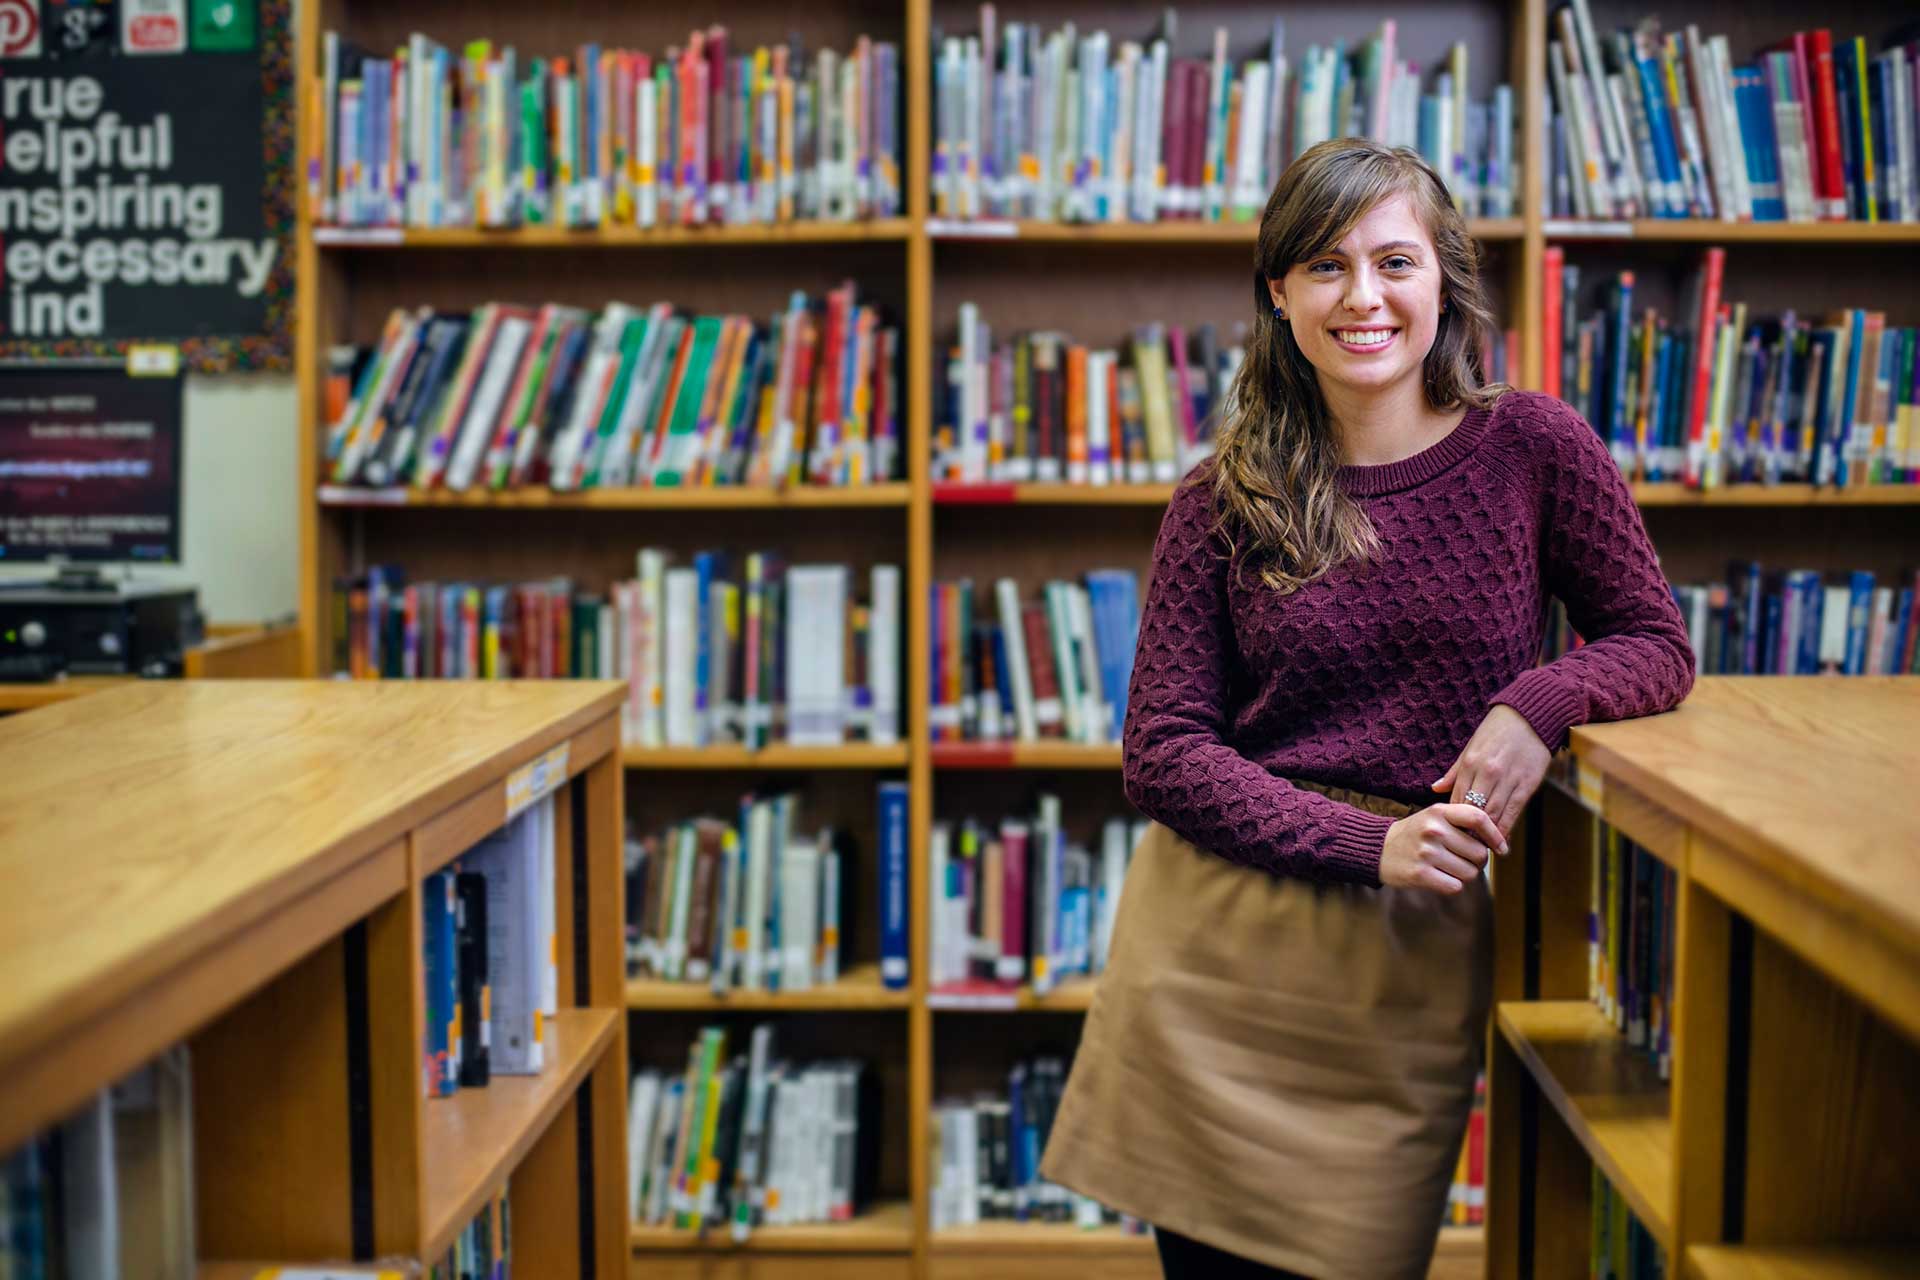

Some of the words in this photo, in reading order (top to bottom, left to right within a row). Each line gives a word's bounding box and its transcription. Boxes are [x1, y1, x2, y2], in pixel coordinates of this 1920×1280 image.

[0, 70, 103, 120] rue
[0, 112, 172, 184] elpful
[0, 174, 222, 239] nspiring
[0, 237, 278, 297] ecessary
[0, 283, 104, 336] ind
